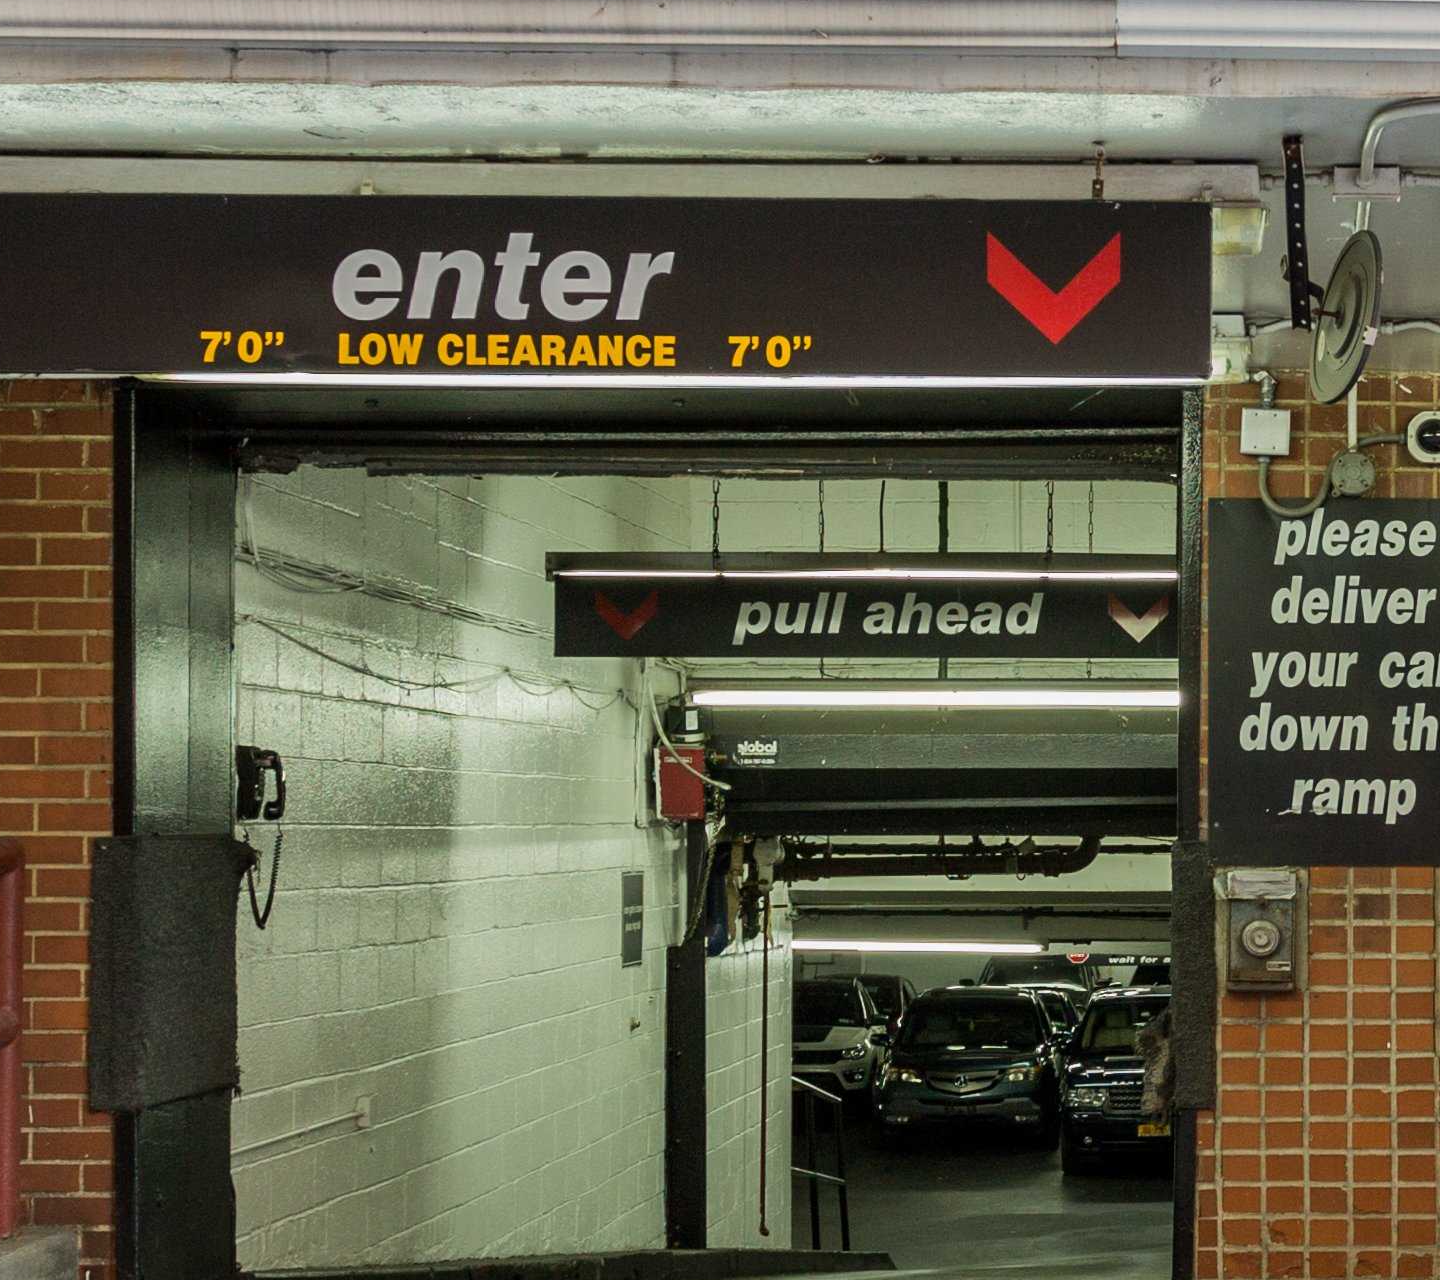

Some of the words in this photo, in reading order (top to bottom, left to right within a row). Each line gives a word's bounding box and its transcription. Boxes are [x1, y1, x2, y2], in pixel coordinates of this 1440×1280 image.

[332, 232, 675, 321] enter
[338, 333, 423, 365] LOW
[437, 333, 676, 368] CLEARANCE
[1274, 507, 1437, 565] please
[732, 592, 847, 645] pull
[862, 592, 1044, 635] ahead
[1271, 575, 1437, 625] deliver
[1250, 651, 1358, 698] your
[1239, 702, 1368, 752] down
[1291, 778, 1417, 825] ramp
[1108, 956, 1135, 964] wait
[1140, 956, 1158, 964] for
